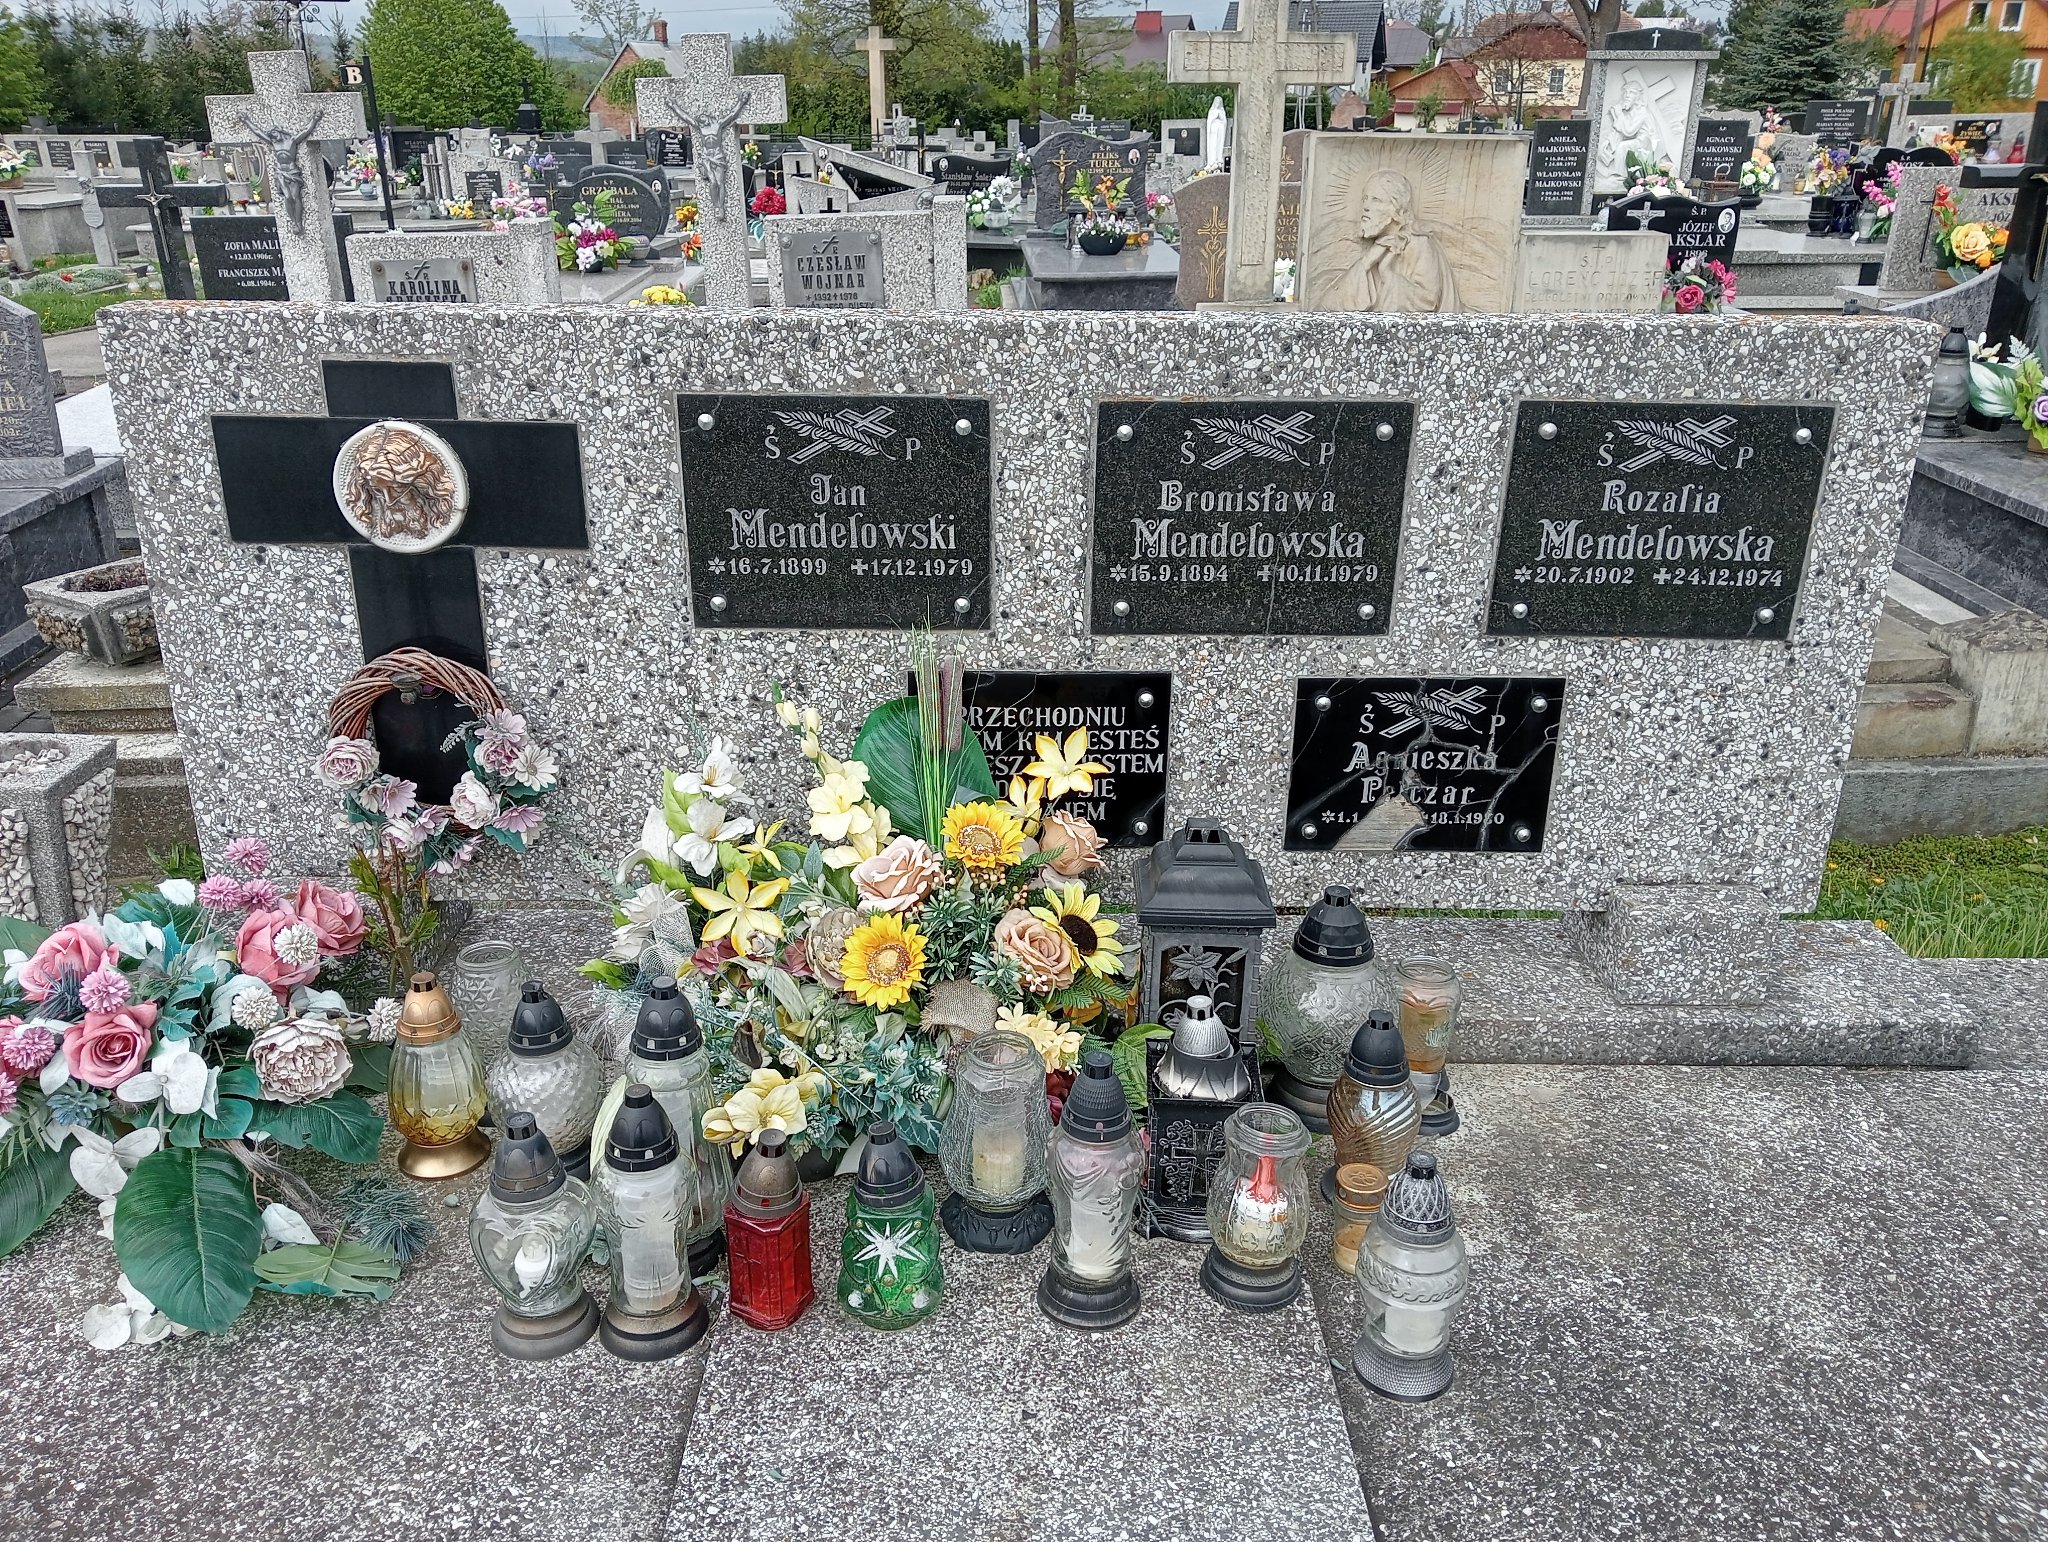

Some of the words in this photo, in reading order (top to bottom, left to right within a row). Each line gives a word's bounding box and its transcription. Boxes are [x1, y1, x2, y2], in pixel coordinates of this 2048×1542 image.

[346, 66, 363, 84] B
[1537, 145, 1587, 153] MAJKOWSKA
[1090, 160, 1121, 168] TUREK
[1535, 180, 1582, 188] MAJKOWSKI
[1678, 220, 1715, 232] JÓZEF
[224, 241, 250, 251] ZOFIA
[218, 268, 270, 278] FRANCISZEK
[797, 254, 866, 272] CZESŁAW
[388, 280, 461, 295] KAROLINA
[801, 273, 865, 290] WOJNAR
[765, 424, 780, 459] Ś
[905, 438, 921, 460] P
[1180, 430, 1196, 465] Ś
[1319, 442, 1335, 465] P
[1597, 431, 1615, 468] Ś
[1735, 446, 1754, 469] P
[810, 473, 866, 506] Jan
[1157, 479, 1336, 513] Bronisława
[1600, 479, 1722, 515] Rozalia
[725, 507, 957, 551] Mendelowski
[1129, 518, 1366, 561] Mendelowska
[1534, 518, 1776, 563] Mendelowska
[728, 557, 827, 575] 16.7.1899
[1129, 564, 1229, 582] 15.9.1894
[1278, 564, 1378, 582] 10.11.1979
[1534, 566, 1635, 585] 20.7.1902
[1672, 567, 1784, 587] 24.12.1974
[961, 706, 1126, 727] PRZECHODNIU
[1358, 703, 1375, 734] Ś
[1488, 714, 1506, 735] P
[1018, 731, 1063, 751] KM
[1085, 725, 1160, 750] ESTEŚ
[1343, 742, 1499, 776] Agnieszka
[1077, 778, 1117, 800] IĘ
[1360, 776, 1476, 805] Pczar
